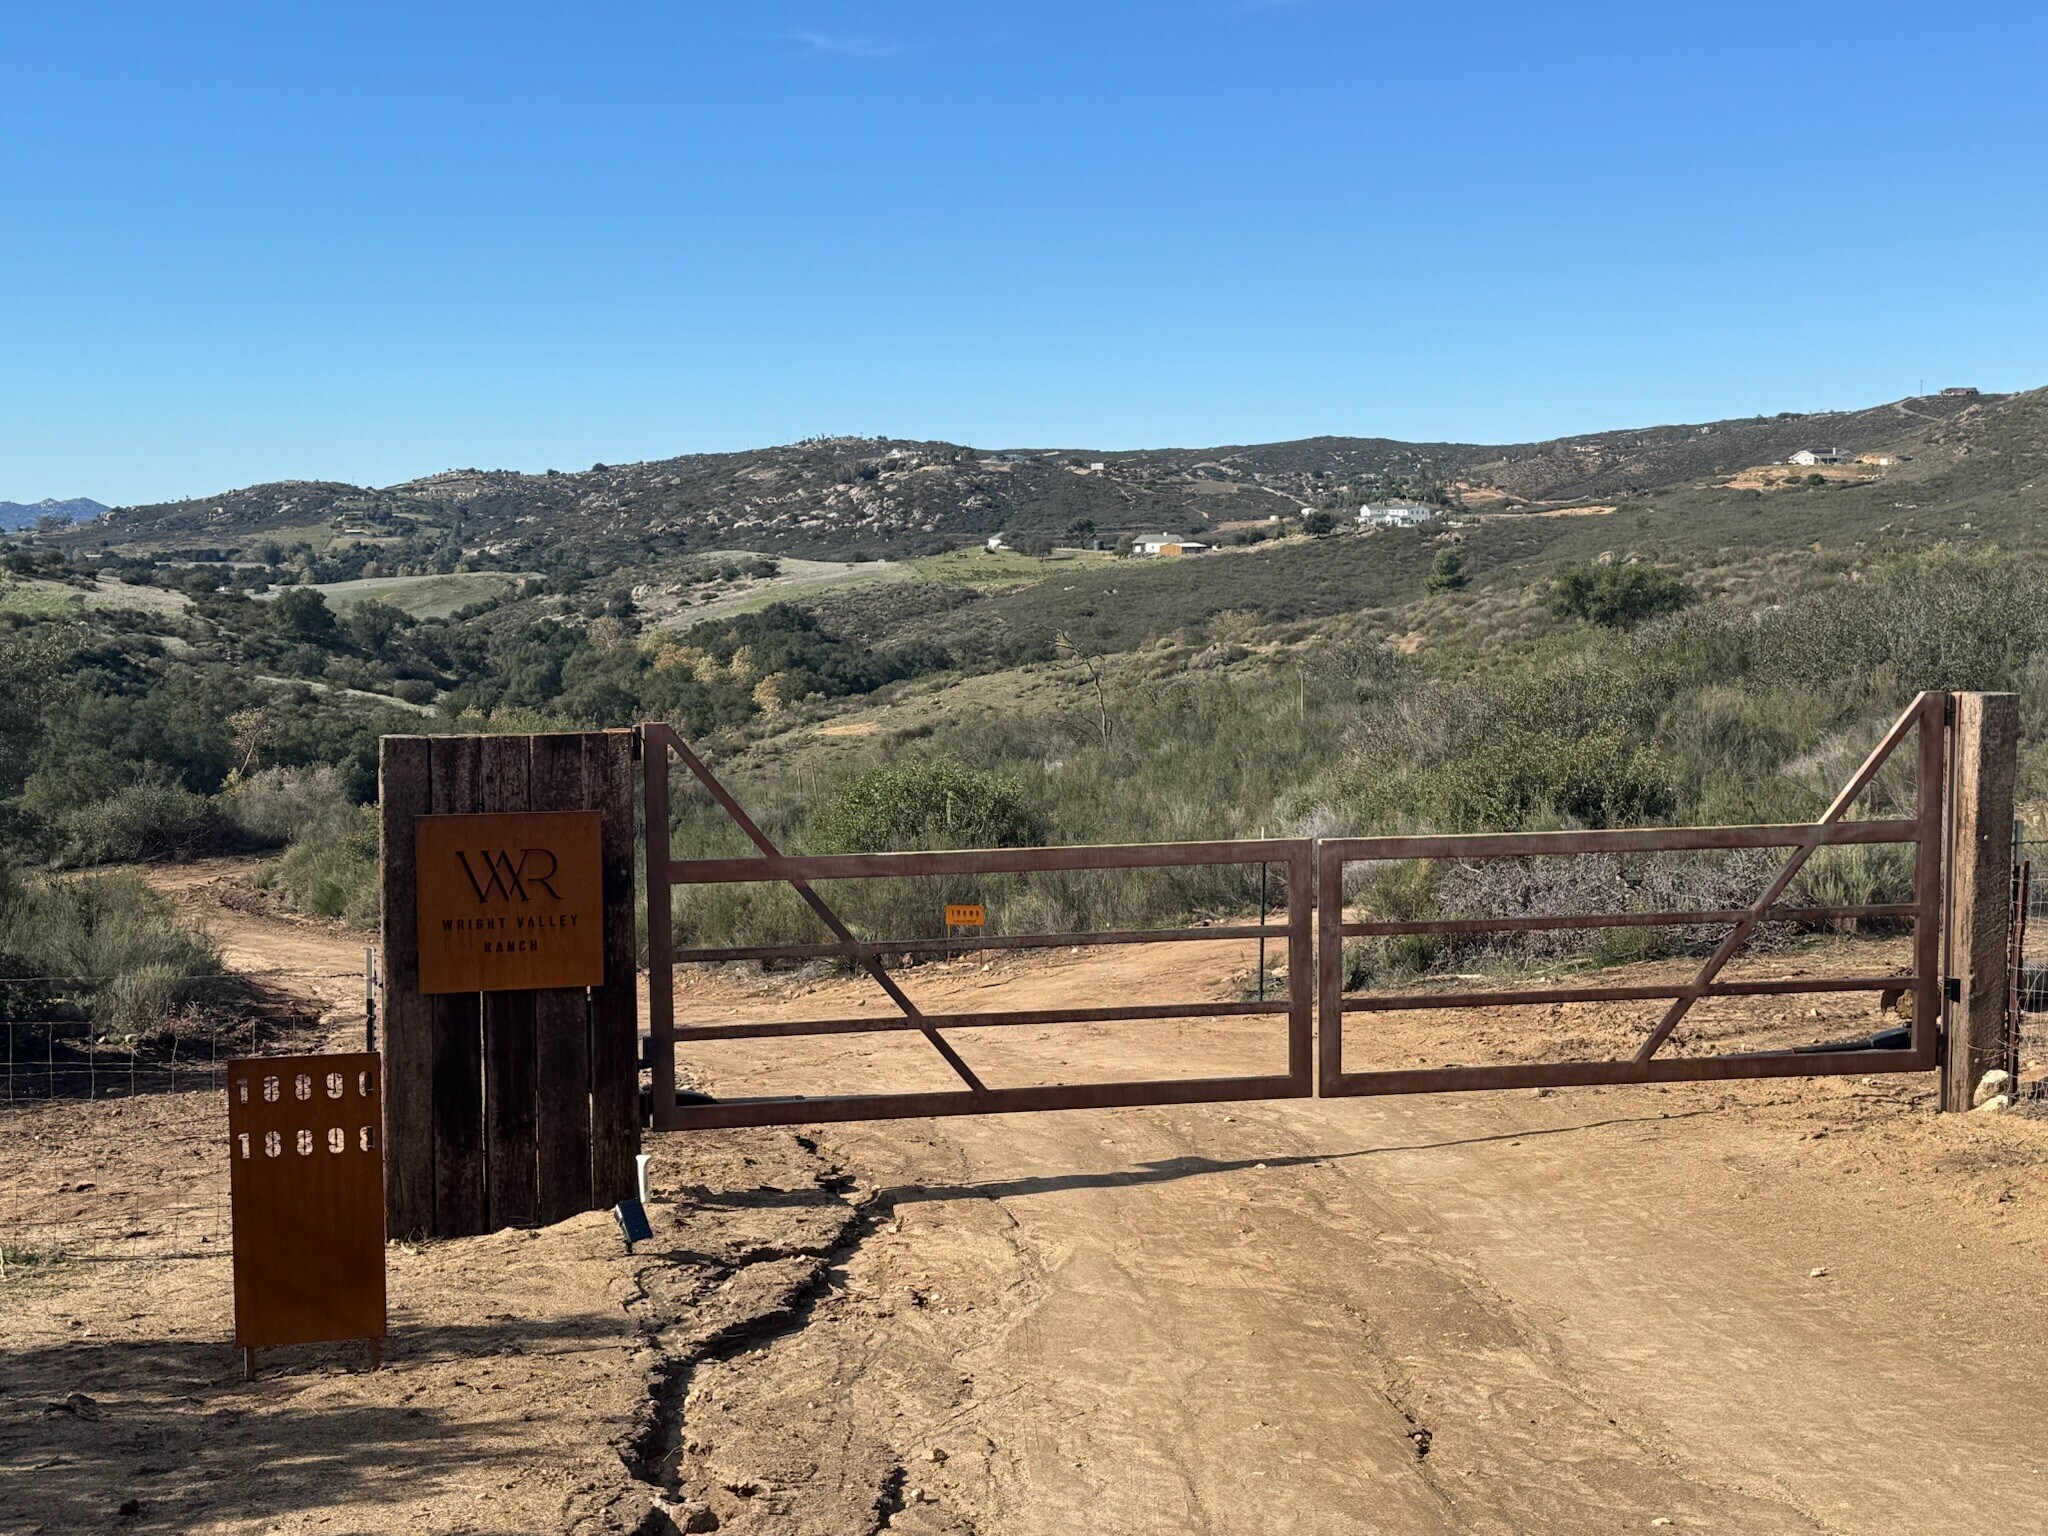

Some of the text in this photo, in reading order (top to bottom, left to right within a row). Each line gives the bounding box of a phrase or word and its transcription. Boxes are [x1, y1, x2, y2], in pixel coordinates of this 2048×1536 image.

[442, 914, 578, 931] WRIGHT VALLEY
[484, 940, 538, 953] RANCH
